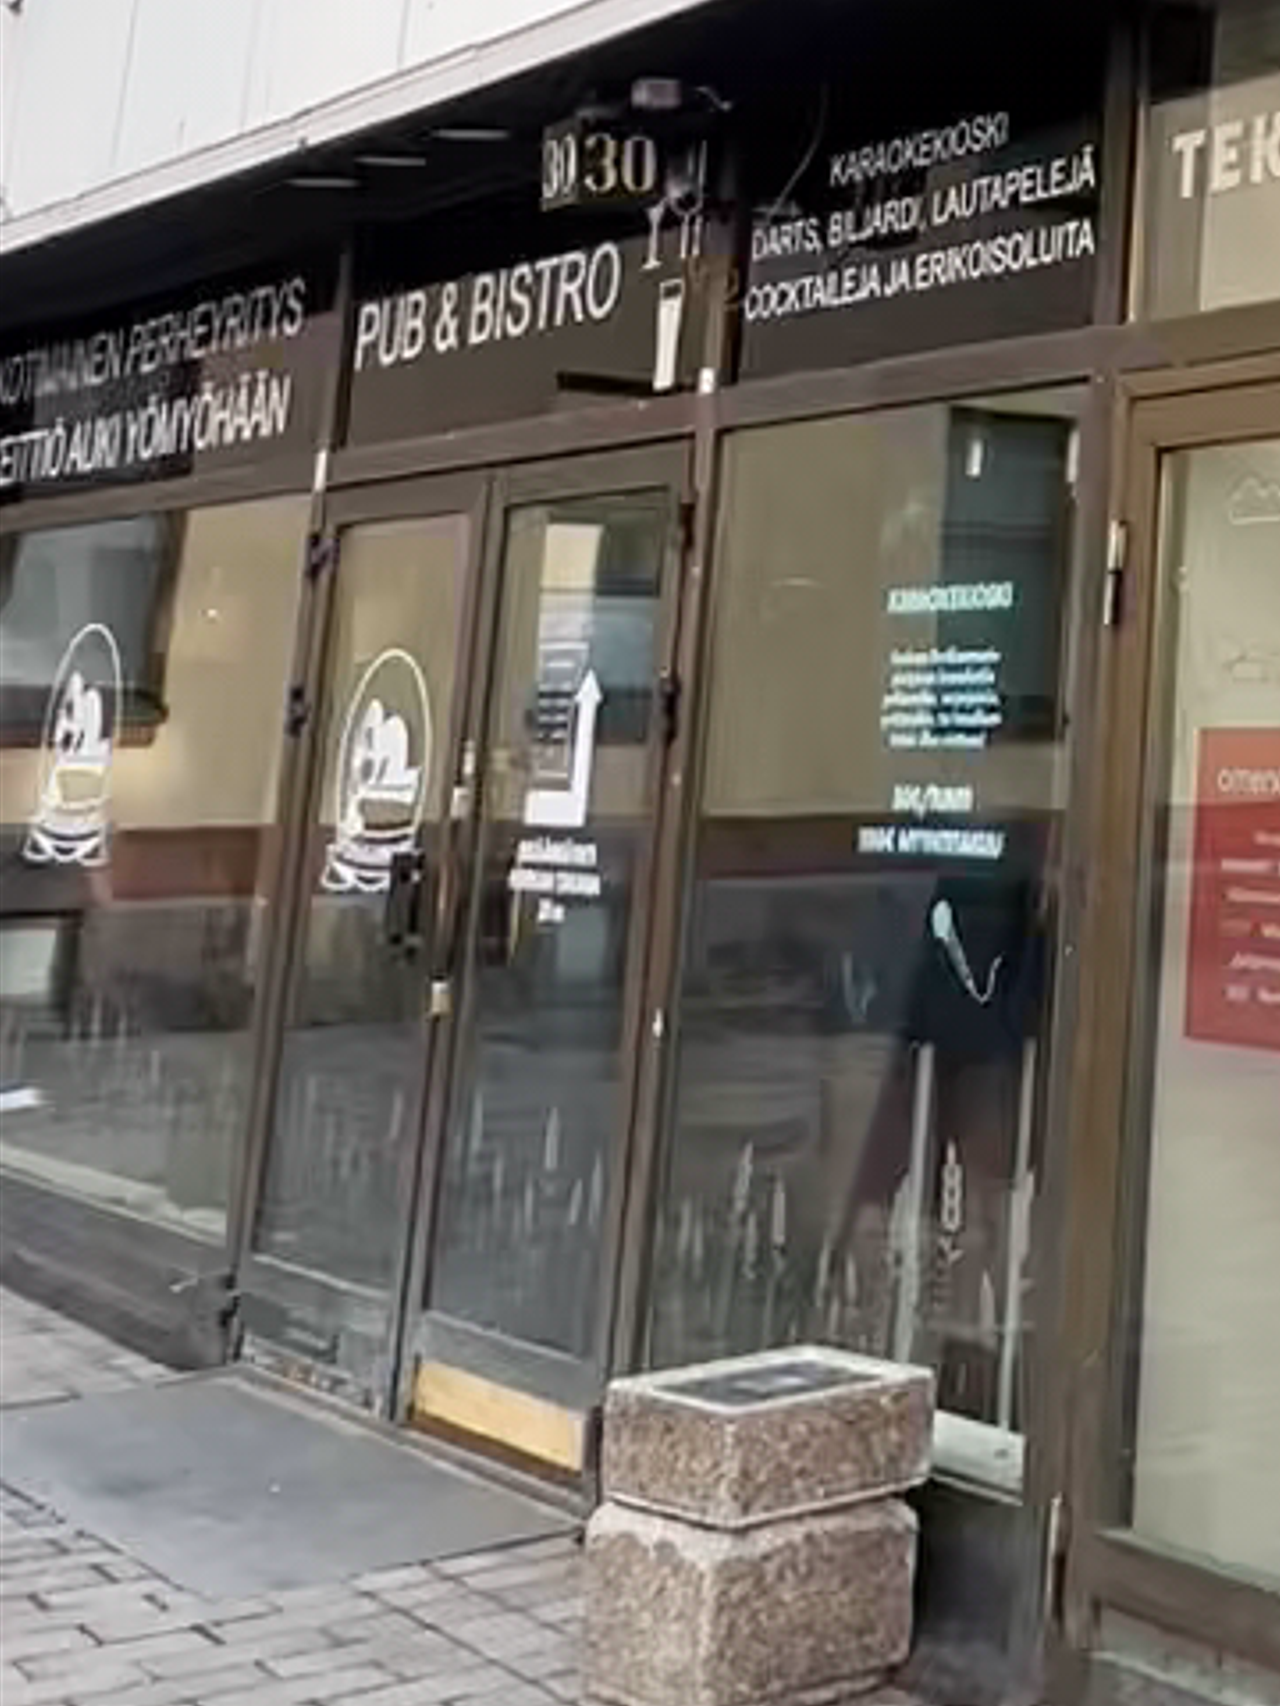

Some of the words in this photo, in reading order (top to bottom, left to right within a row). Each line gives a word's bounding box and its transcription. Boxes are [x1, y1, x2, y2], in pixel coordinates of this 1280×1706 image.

[583, 133, 657, 193] 30
[353, 288, 427, 372] PUB
[432, 280, 461, 354] &
[467, 241, 622, 345] BISTRO
